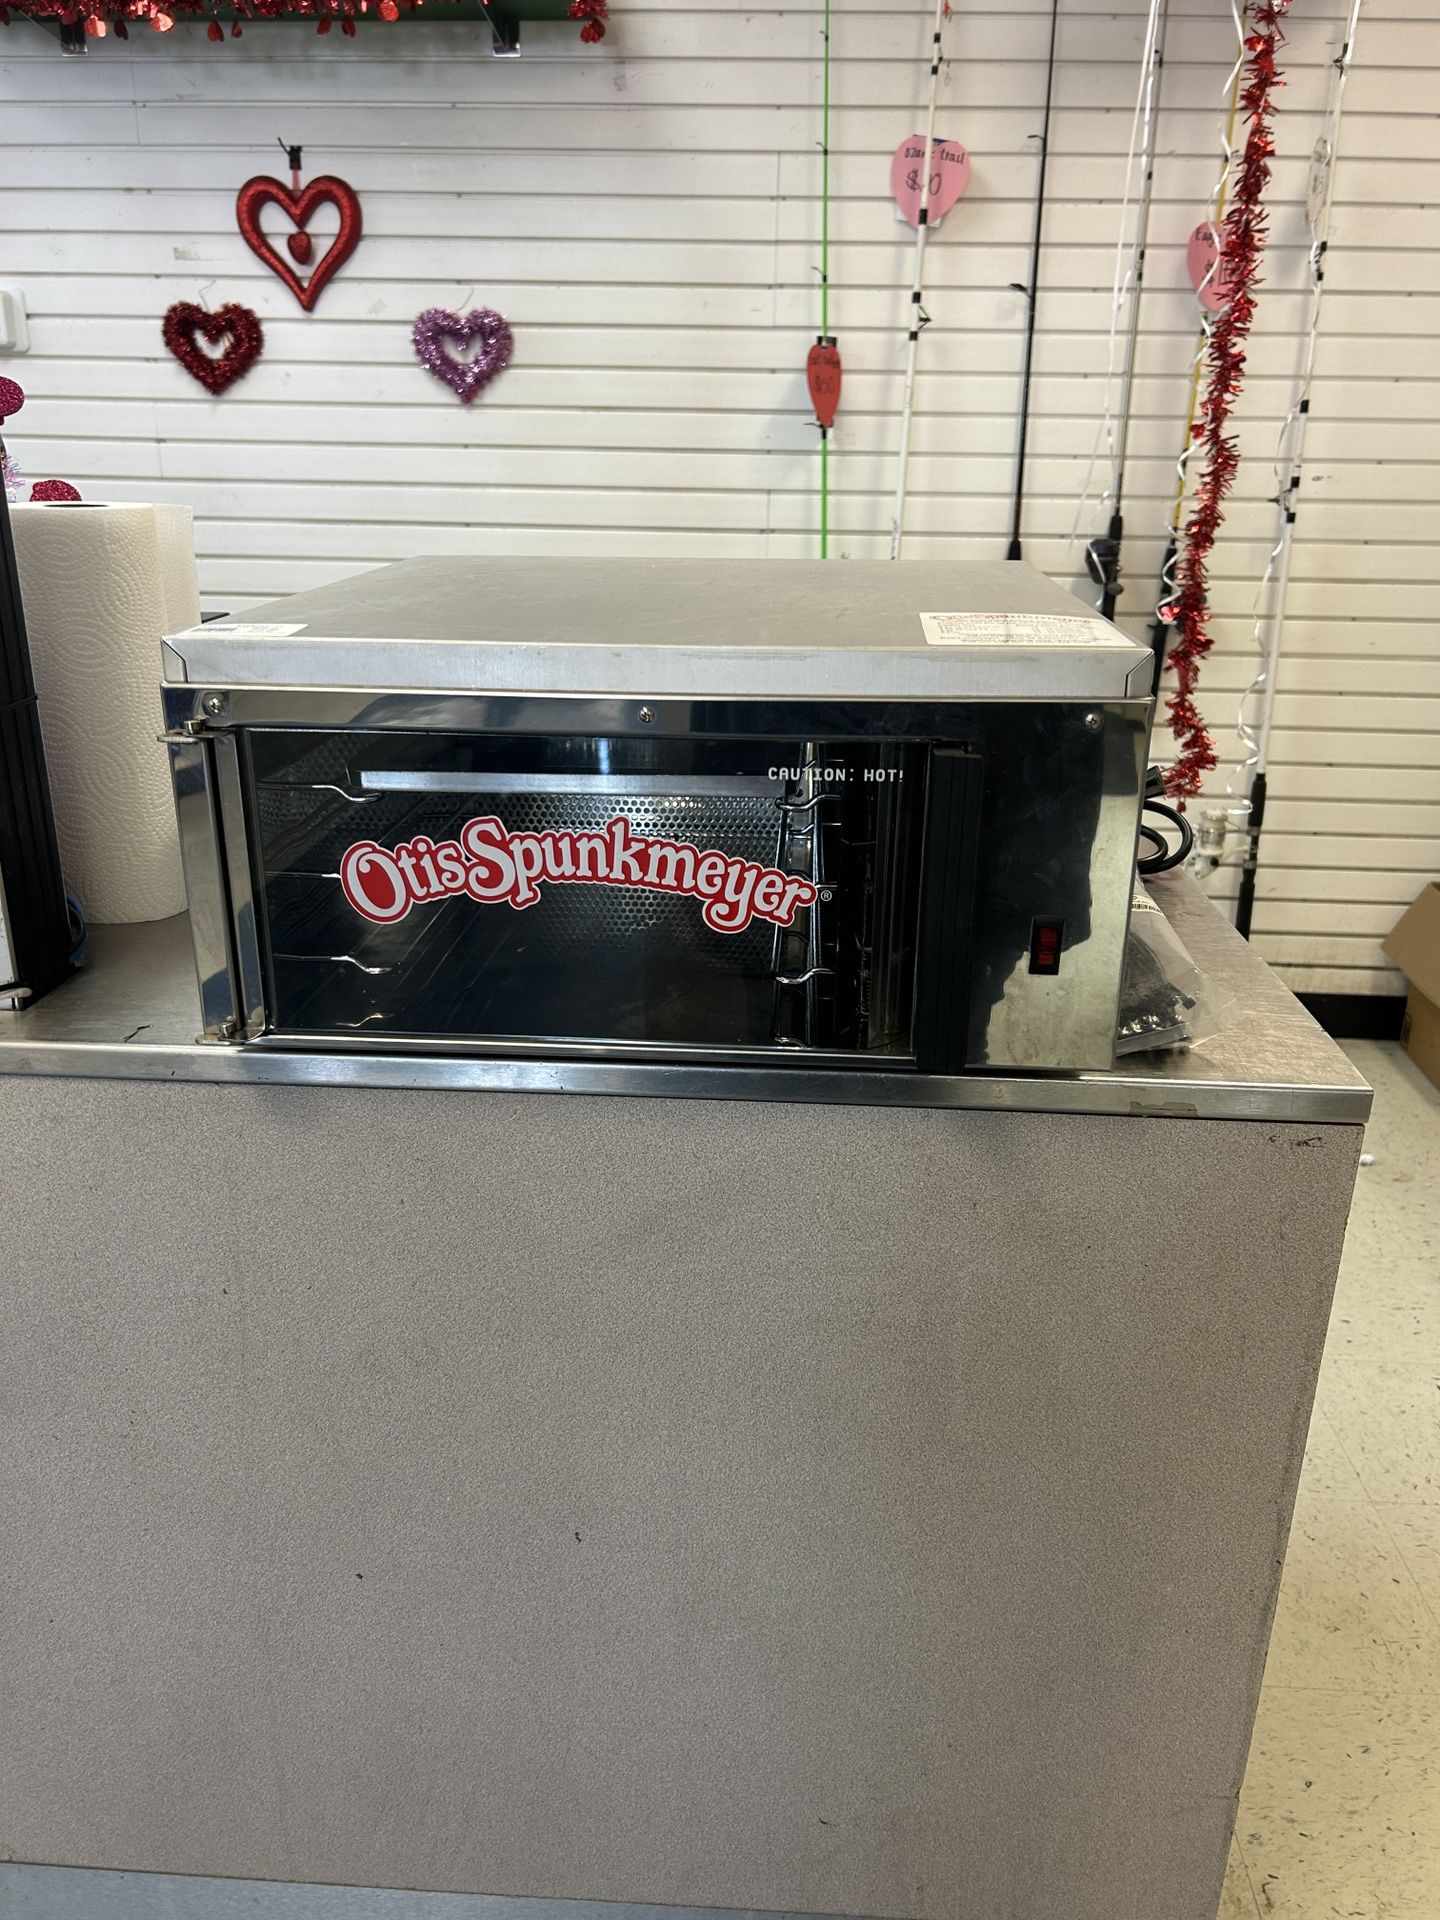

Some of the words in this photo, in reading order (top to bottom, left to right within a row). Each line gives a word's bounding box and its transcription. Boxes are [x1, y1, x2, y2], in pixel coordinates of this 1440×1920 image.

[905, 168, 942, 196] $0
[768, 766, 854, 782] CAUTION:
[863, 769, 904, 783] HOT!
[342, 837, 468, 924] Otis
[461, 815, 818, 934] Spunkmeyer
